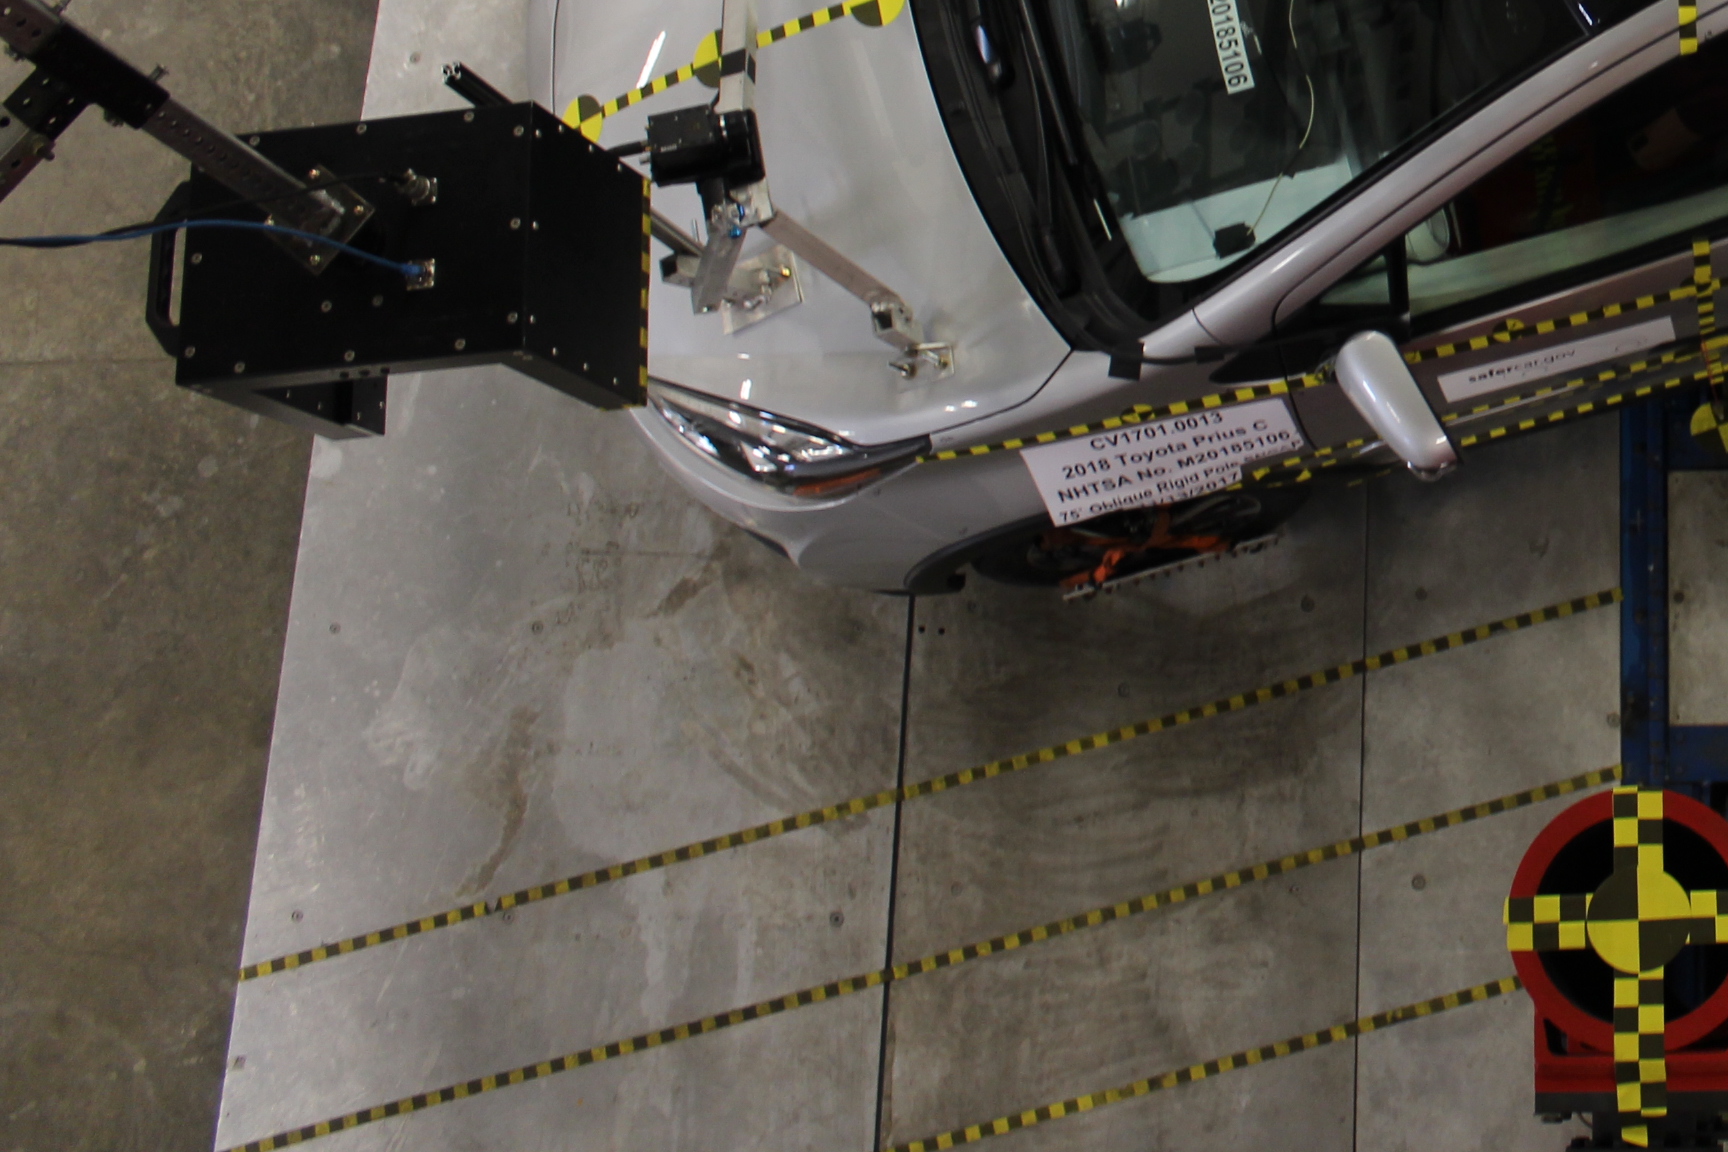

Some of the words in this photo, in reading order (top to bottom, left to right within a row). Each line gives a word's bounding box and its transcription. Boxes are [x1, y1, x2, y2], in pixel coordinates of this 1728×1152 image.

[1468, 350, 1575, 384] safercar.gov
[1062, 458, 1110, 480] 2018
[1117, 442, 1187, 467] Toyota
[1193, 426, 1247, 447] Prius
[1253, 419, 1269, 431] C
[1090, 411, 1224, 451] CV1701.0013
[1058, 475, 1132, 503] NHTSA
[1137, 466, 1172, 482] No.
[1177, 430, 1290, 470] M20185106
[1090, 489, 1152, 514] Oblique
[1157, 473, 1199, 494] Rigid
[1203, 461, 1239, 477] Pole
